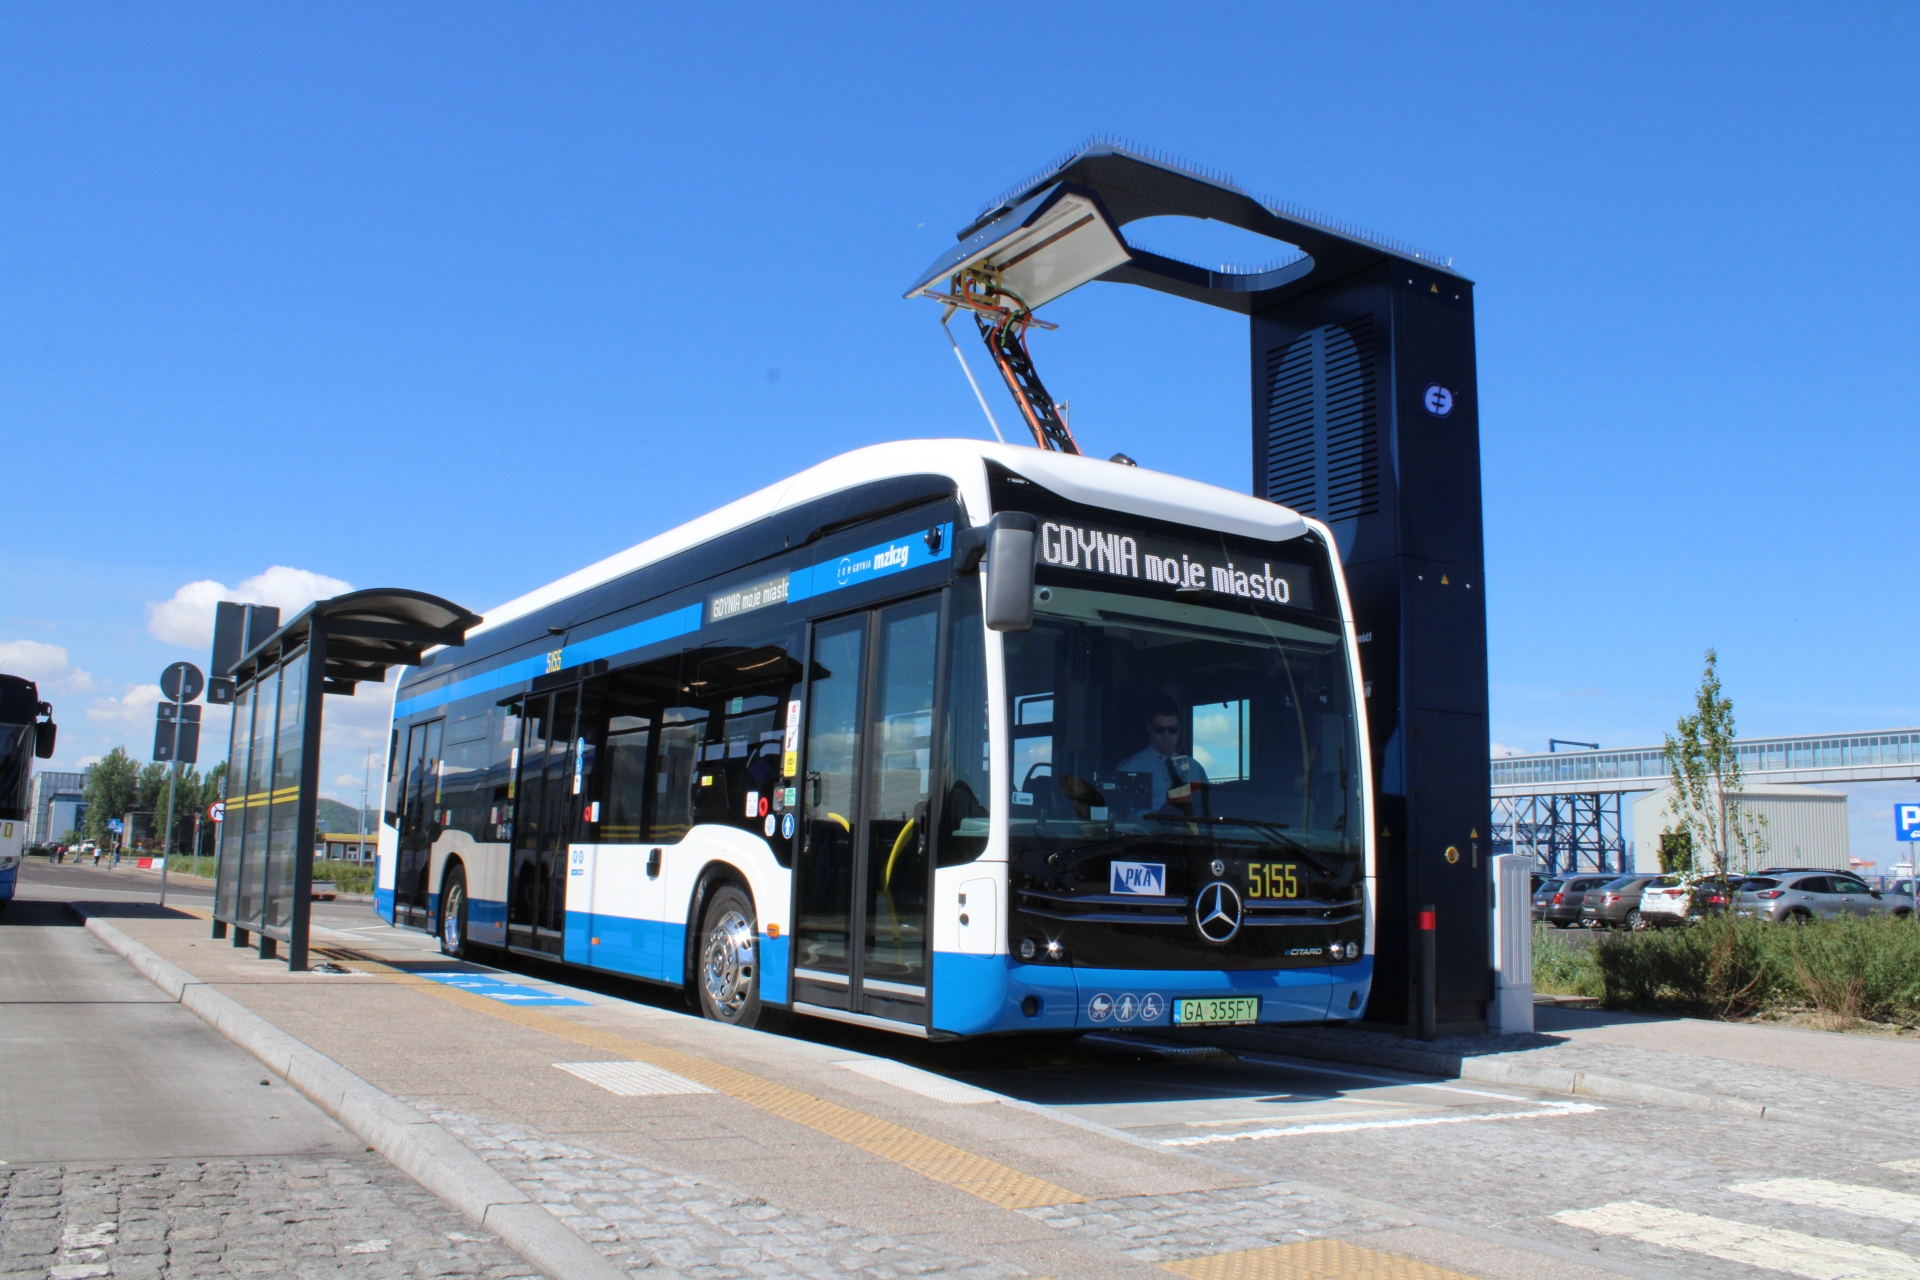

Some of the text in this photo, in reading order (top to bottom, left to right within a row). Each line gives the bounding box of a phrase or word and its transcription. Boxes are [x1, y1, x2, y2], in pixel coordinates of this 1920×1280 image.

[873, 544, 909, 570] mzkzg
[1042, 522, 1290, 603] GDYNIA moje miasto
[713, 592, 741, 618] GDYNIA
[741, 587, 761, 610] moje
[546, 649, 563, 674] 5155
[1901, 805, 1920, 831] P
[1125, 868, 1152, 887] PKA
[1248, 863, 1297, 898] 5155
[1184, 1000, 1254, 1020] GA 355FY
